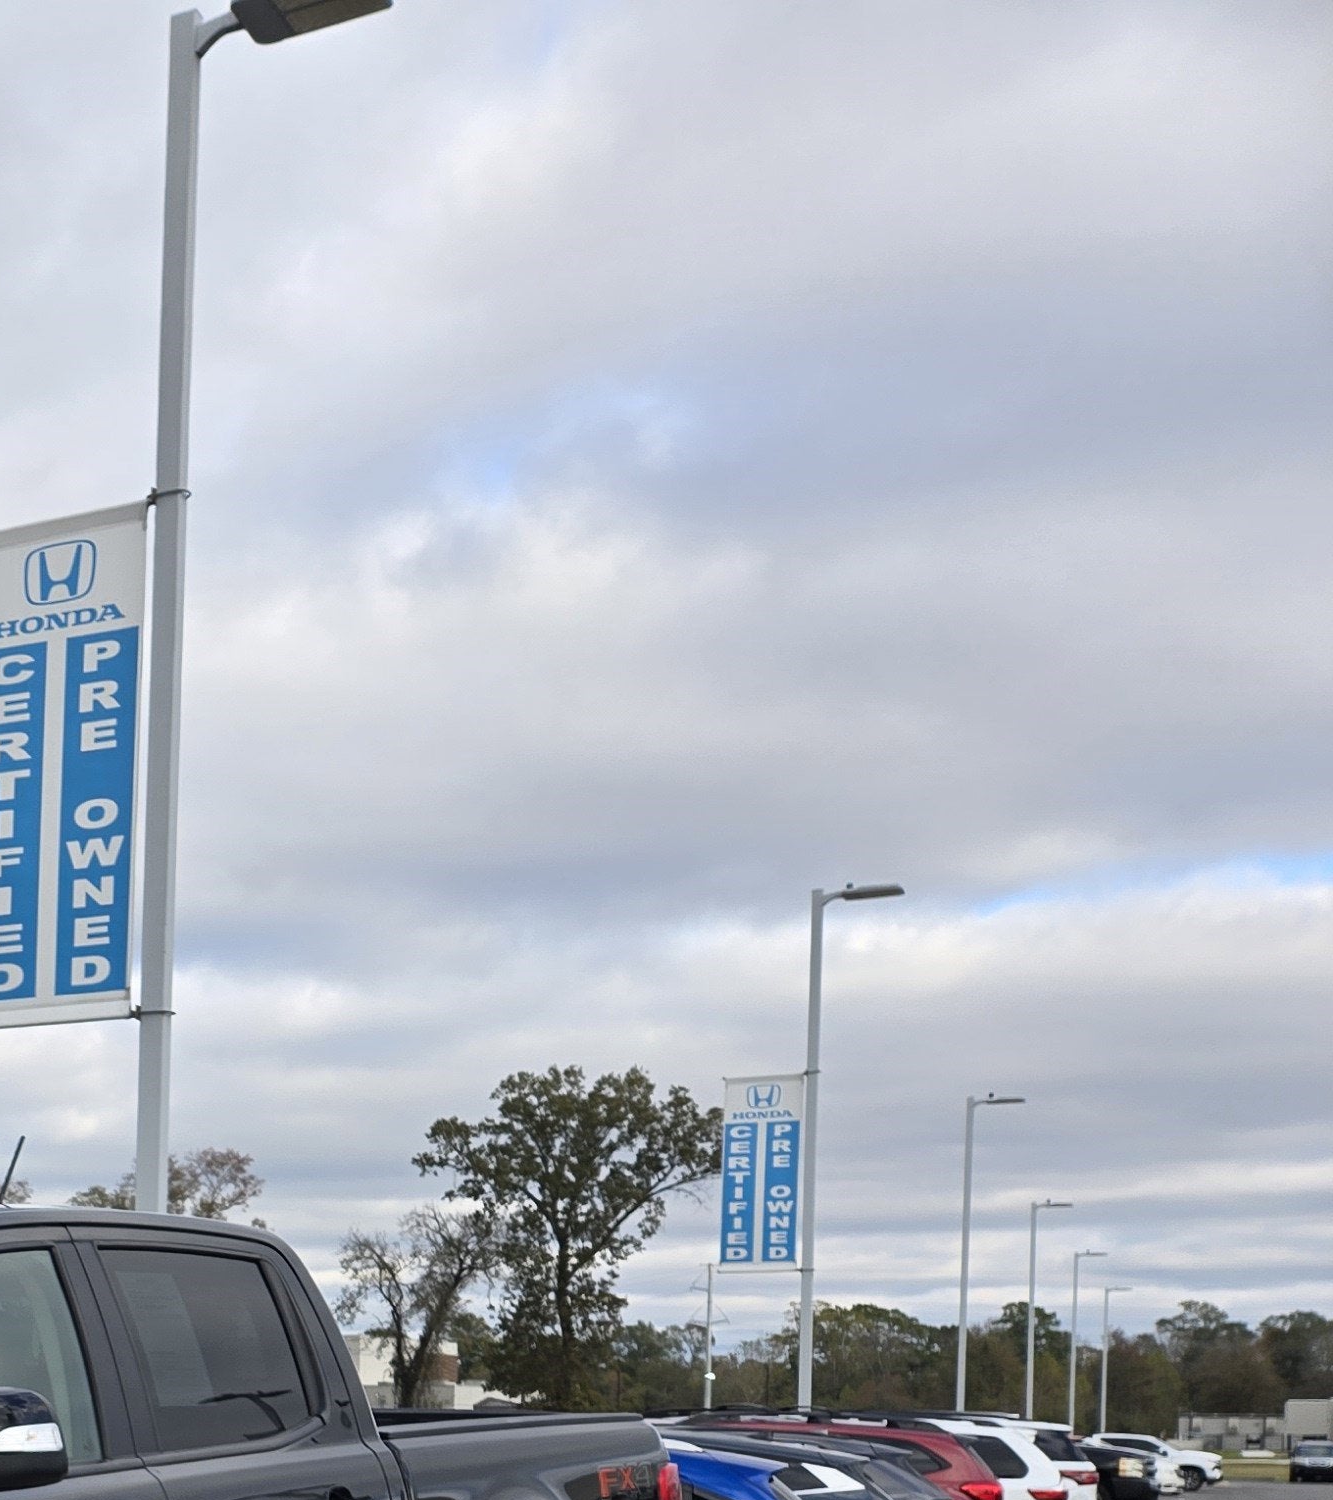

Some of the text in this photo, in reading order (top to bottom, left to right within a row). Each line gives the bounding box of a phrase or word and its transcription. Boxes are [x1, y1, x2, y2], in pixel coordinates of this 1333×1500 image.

[64, 639, 125, 989] PRE OWNED
[732, 1109, 794, 1121] HONDA
[725, 1125, 753, 1261] CERTIFIED
[597, 1461, 653, 1500] FX4
